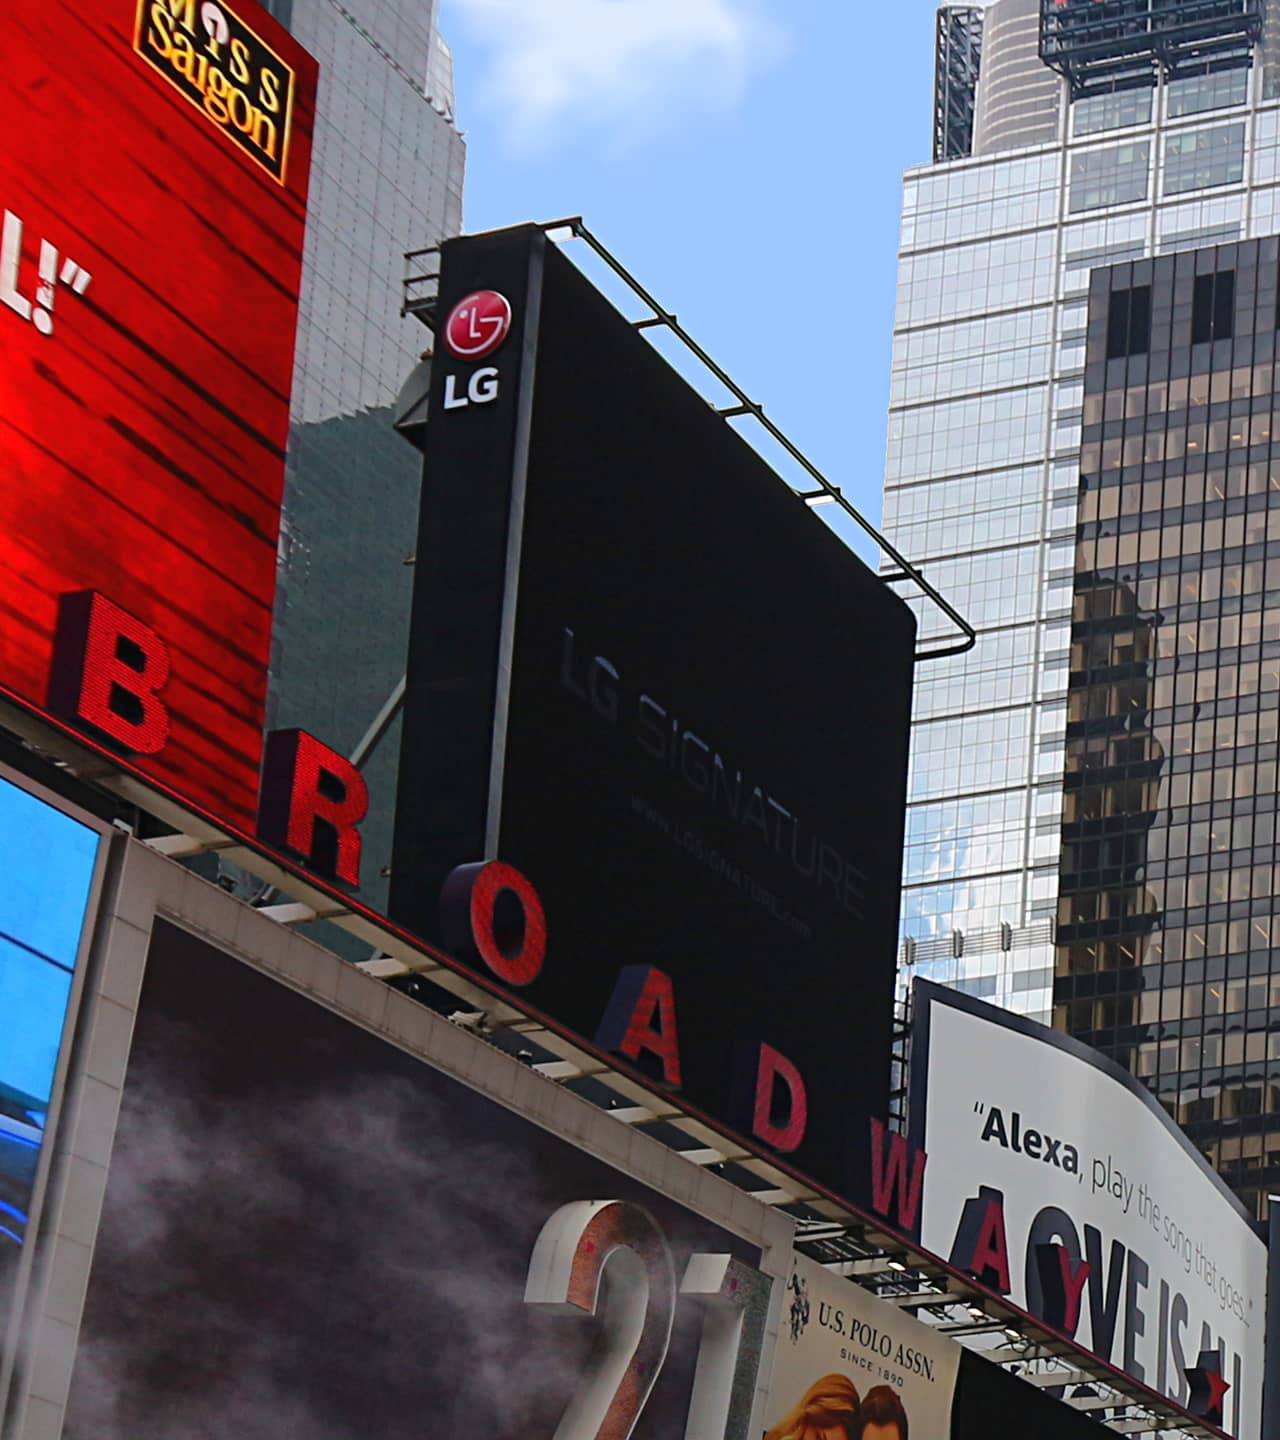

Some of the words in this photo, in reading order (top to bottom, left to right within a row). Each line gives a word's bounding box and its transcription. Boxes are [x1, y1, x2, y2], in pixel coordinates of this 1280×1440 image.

[148, 4, 277, 162] Saigon
[443, 368, 499, 410] LG
[560, 626, 621, 723] LG
[1091, 1155, 1134, 1214] play
[1138, 1183, 1161, 1233] the
[1163, 1214, 1193, 1273] song
[1195, 1242, 1217, 1290] that
[818, 1301, 848, 1334] U.S.
[850, 1317, 894, 1362] POLO
[894, 1340, 936, 1383] ASSN.
[839, 1347, 874, 1372] SINCE
[875, 1363, 905, 1389] 1890
